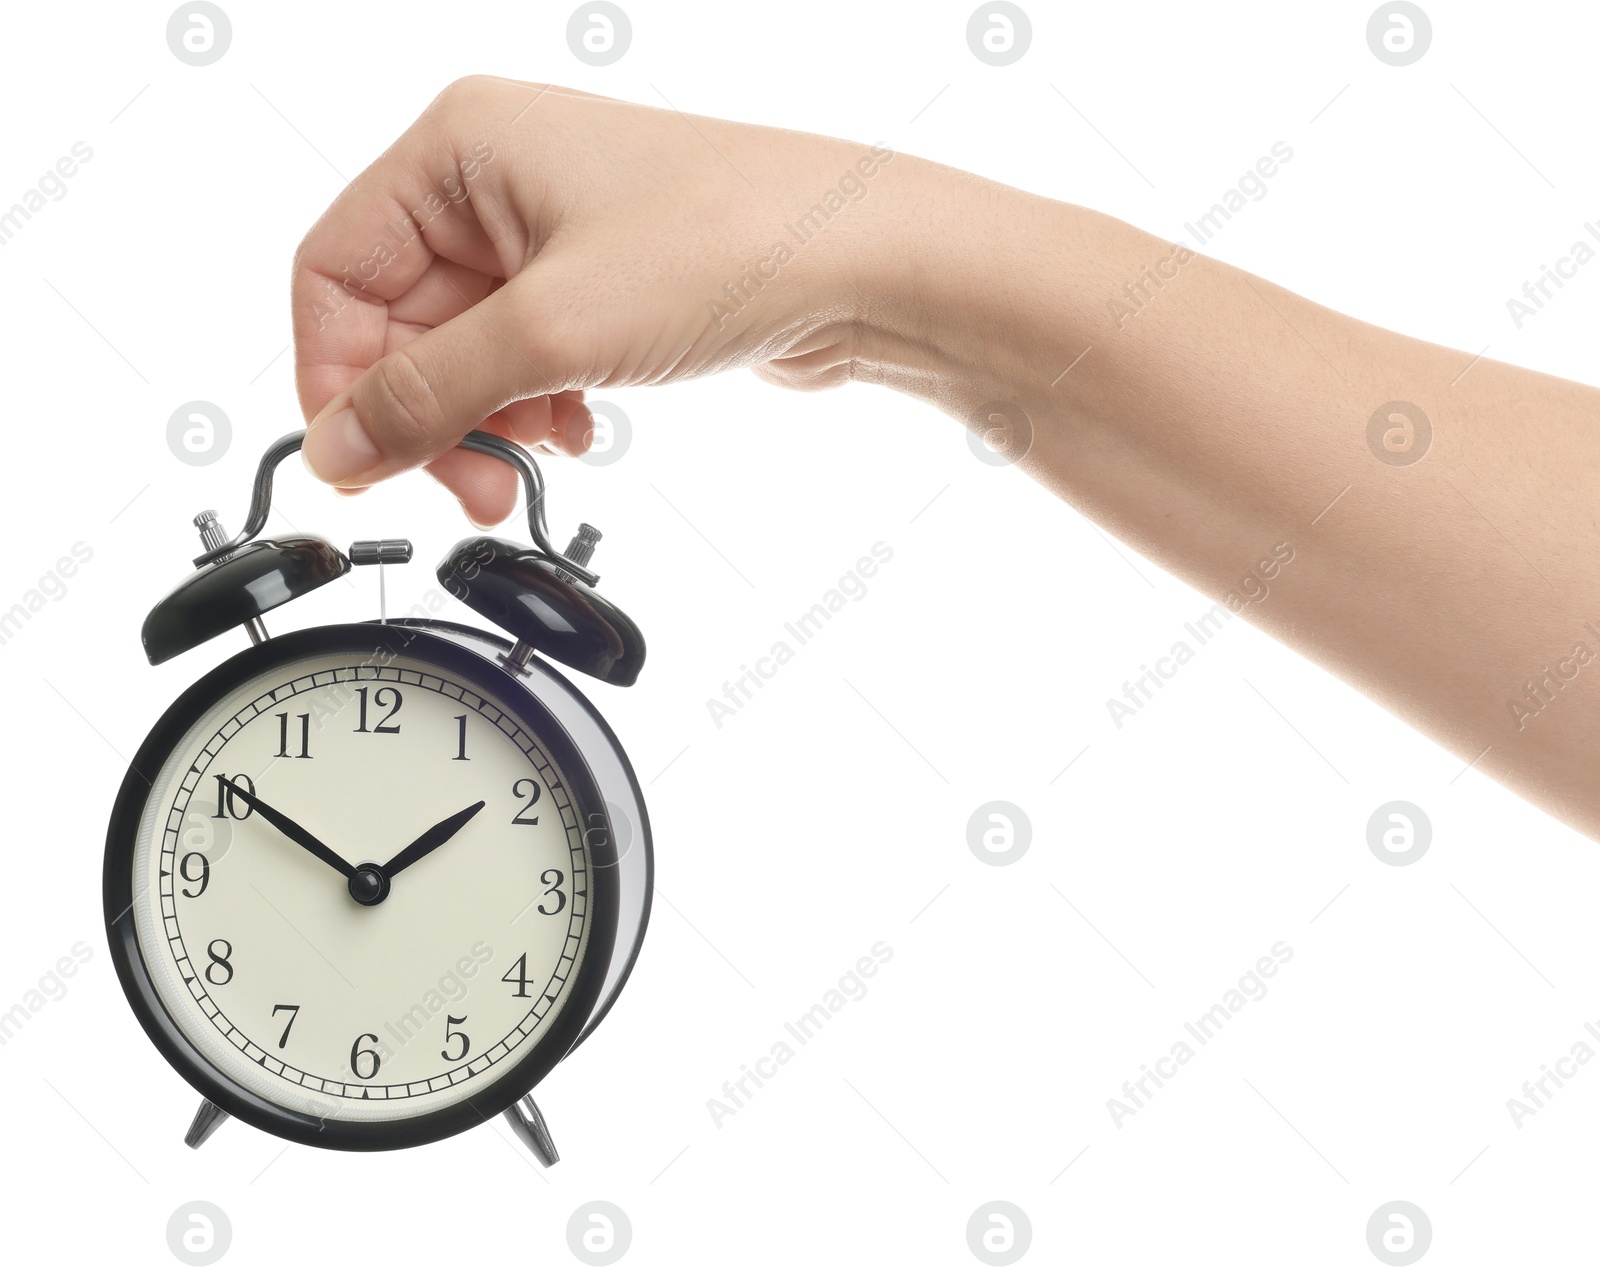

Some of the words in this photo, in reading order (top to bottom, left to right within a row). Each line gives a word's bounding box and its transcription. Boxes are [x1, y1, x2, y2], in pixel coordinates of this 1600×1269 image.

[353, 686, 403, 734] 12
[273, 712, 314, 759] 11
[452, 714, 471, 761] 1
[211, 773, 256, 821] 10
[511, 778, 541, 826] 2
[179, 851, 210, 899] 9
[537, 869, 567, 916] 3
[205, 939, 234, 986] 8
[501, 952, 534, 998] 4
[271, 1004, 301, 1049] 7
[441, 1014, 470, 1062] 5
[350, 1033, 381, 1080] 6
